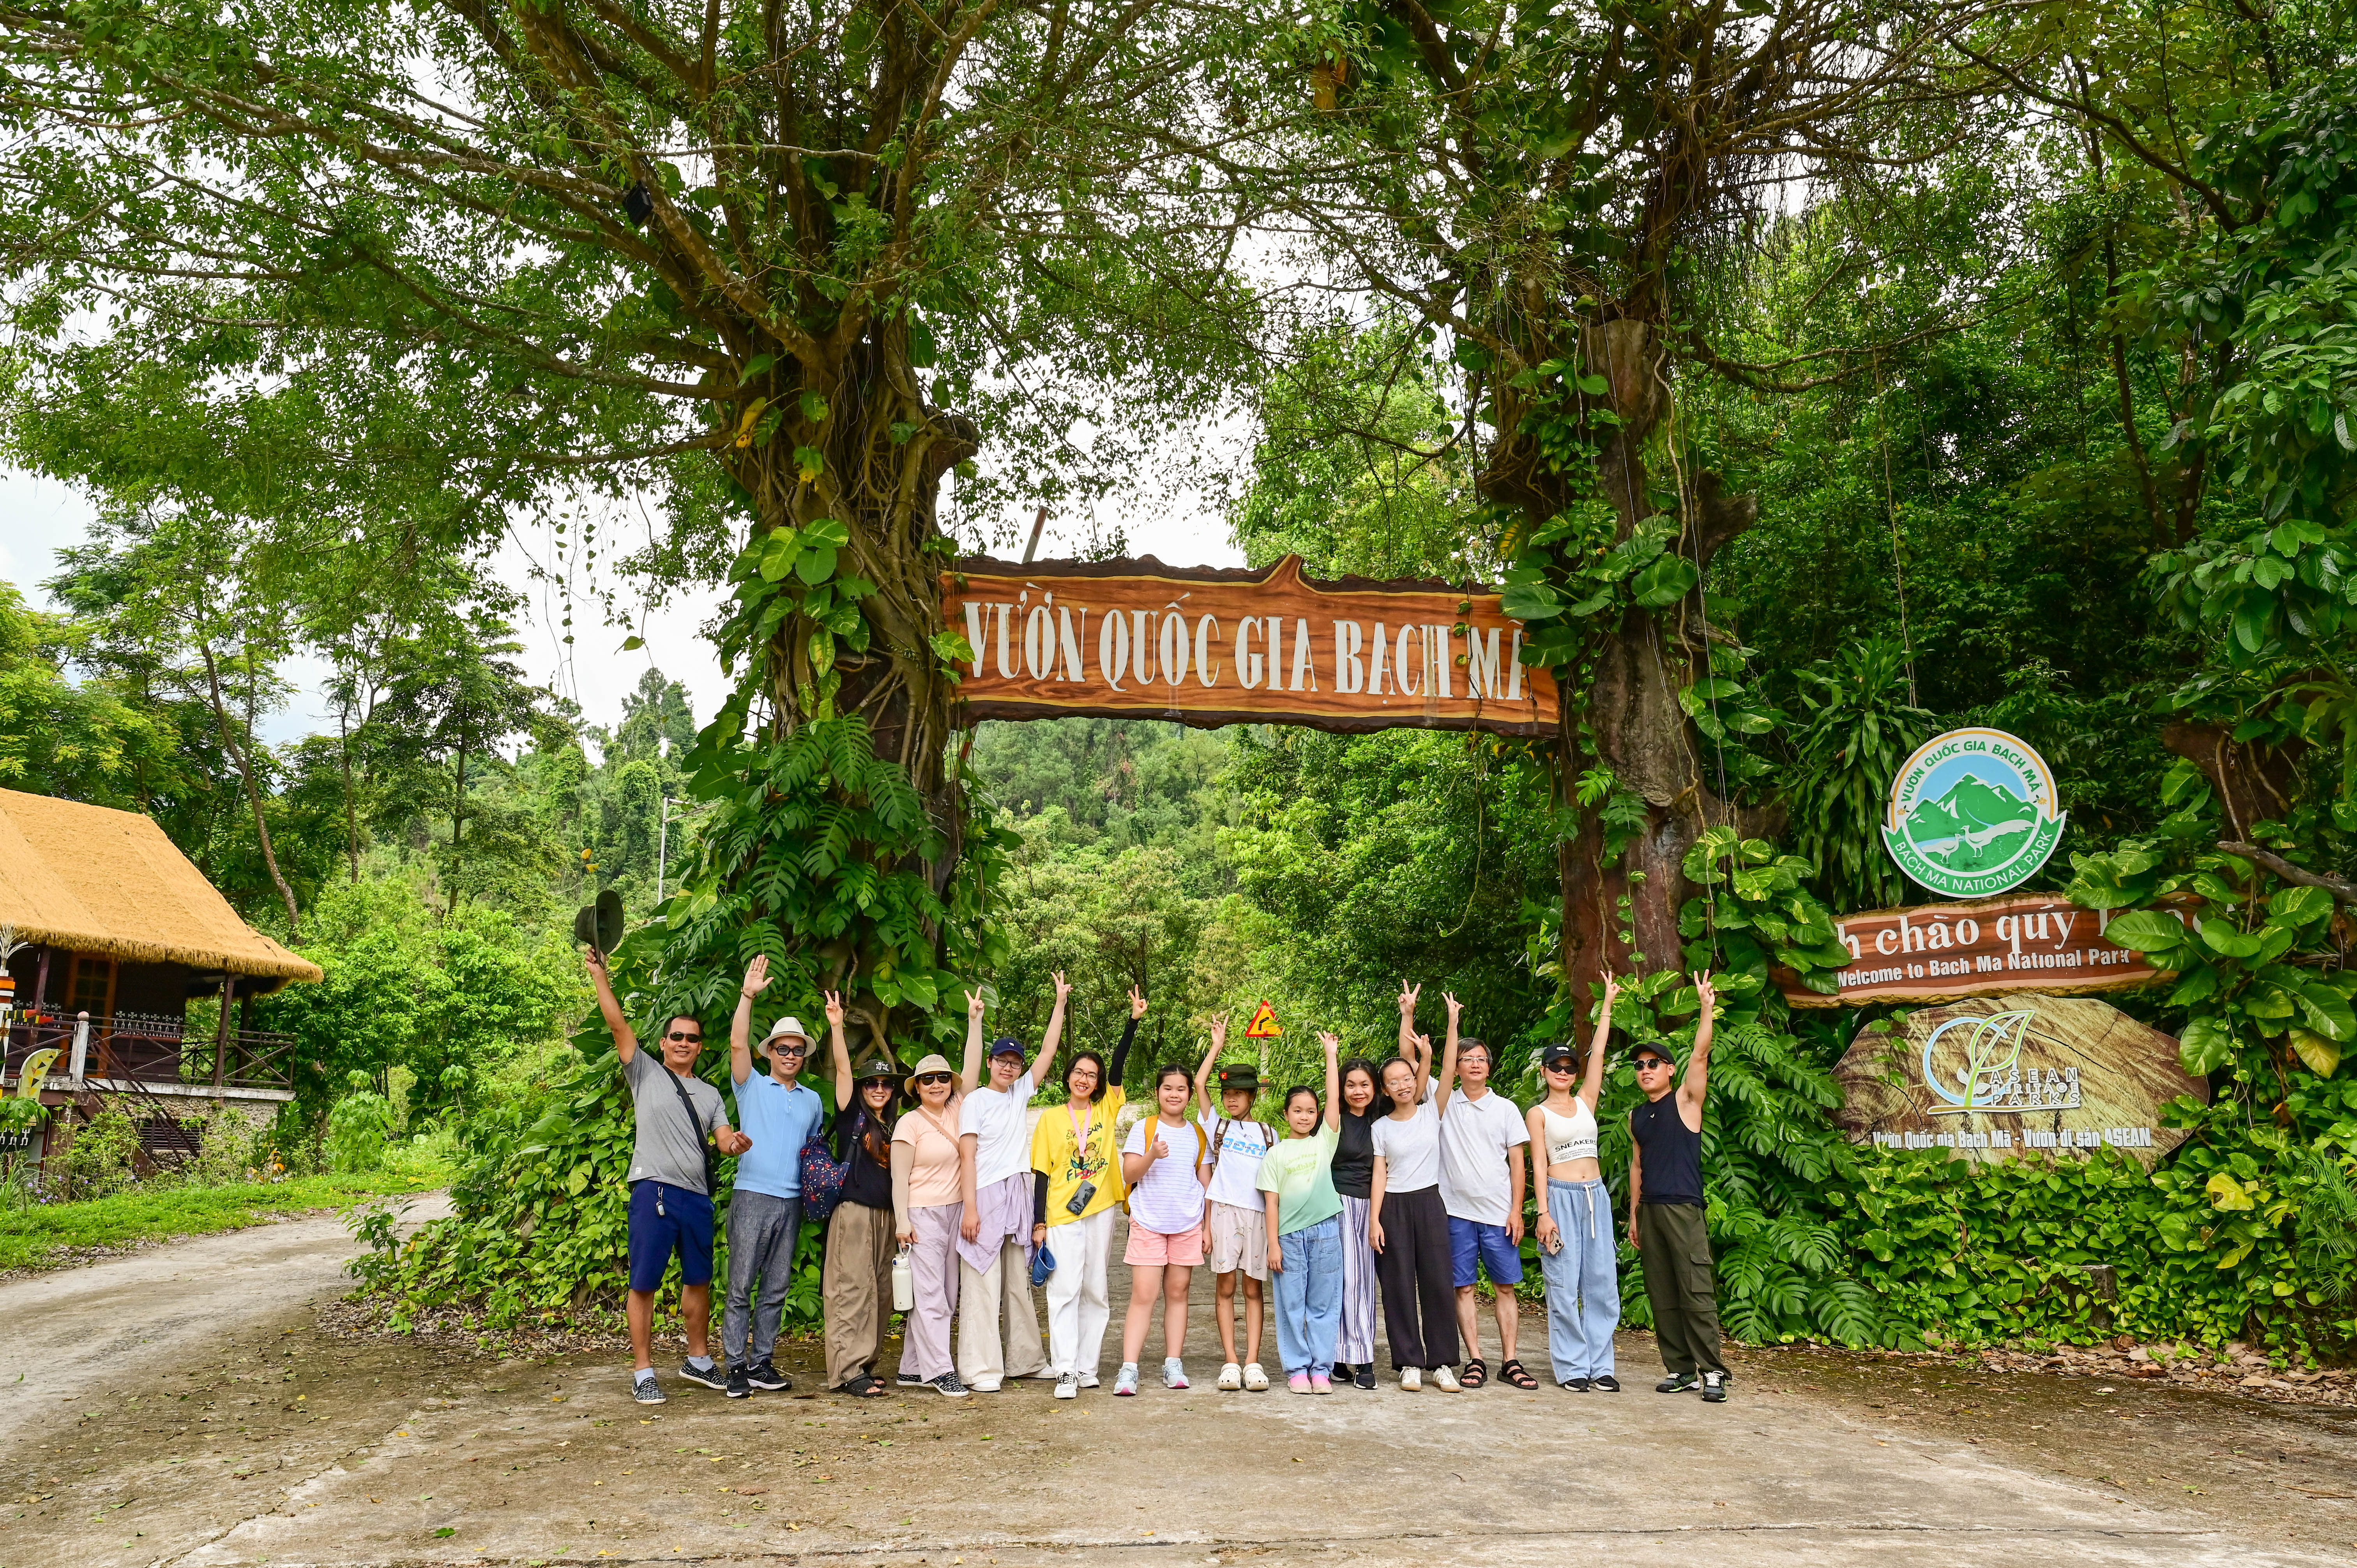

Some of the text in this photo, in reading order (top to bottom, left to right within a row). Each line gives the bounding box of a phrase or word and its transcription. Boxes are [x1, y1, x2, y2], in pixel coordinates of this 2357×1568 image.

[962, 582, 1088, 682] VƯỜN
[1099, 592, 1220, 692] QUỐC
[1235, 615, 1318, 692] GIA
[1332, 620, 1454, 705] BẠCH
[1901, 740, 2043, 802] VƯỜN QUỐC GIA BẠCH MÃ
[1894, 830, 2053, 892] BACH MA NATIONAL PARK
[1875, 914, 1980, 955] chào
[1996, 904, 2079, 954] quý
[1836, 948, 2130, 987] Welcome to Bach Ma National Park
[1990, 1068, 2078, 1083] ASEAN
[1992, 1083, 2078, 1094] HERITAGE
[1992, 1092, 2079, 1104] PARKS
[1555, 1139, 1596, 1152] SNEAKERS
[1904, 1128, 1934, 1150] Quốc
[1957, 1130, 1988, 1153] Bạch
[1991, 1130, 2012, 1148] Mã
[2022, 1128, 2057, 1148] Vườn
[2060, 1128, 2073, 1147] di
[2076, 1126, 2101, 1147] sản
[2104, 1127, 2152, 1147] ASEAN
